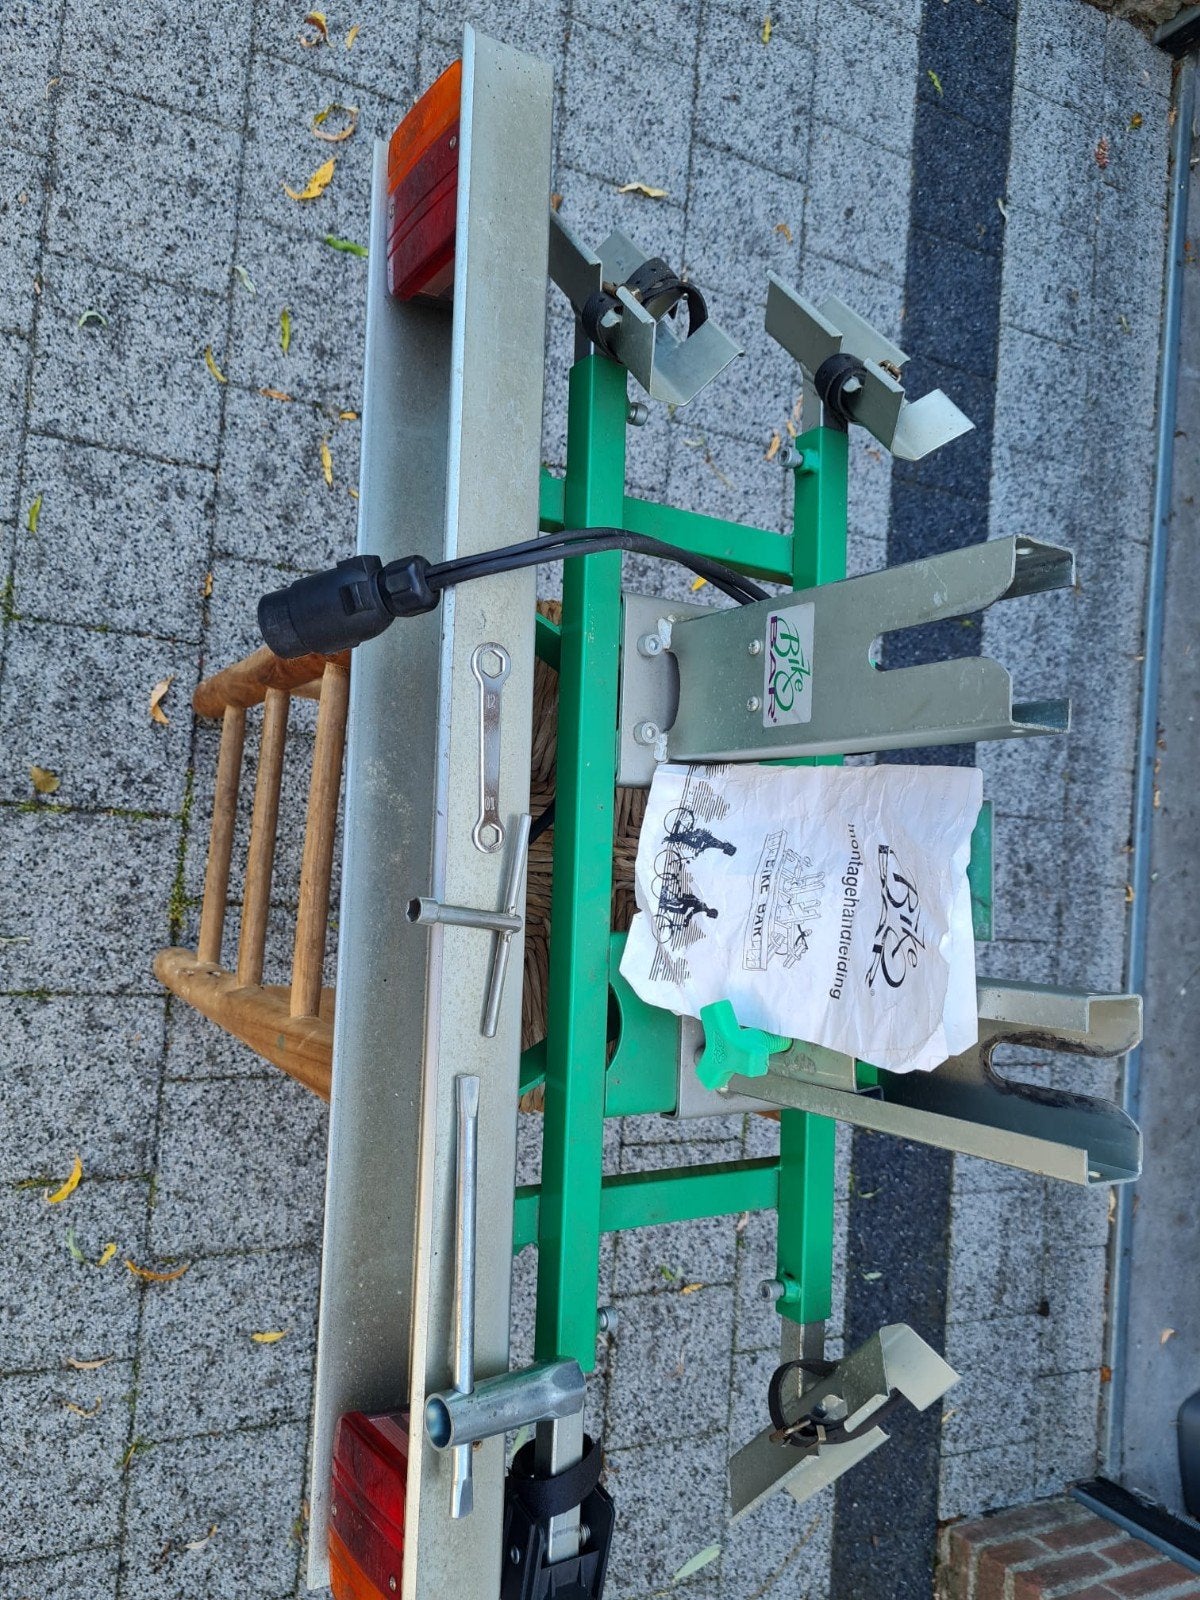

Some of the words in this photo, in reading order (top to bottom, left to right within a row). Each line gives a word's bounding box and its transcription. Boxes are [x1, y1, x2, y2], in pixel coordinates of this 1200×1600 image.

[773, 617, 811, 712] Bike
[829, 823, 864, 1000] montagehandleiding
[880, 849, 926, 989] Bike
